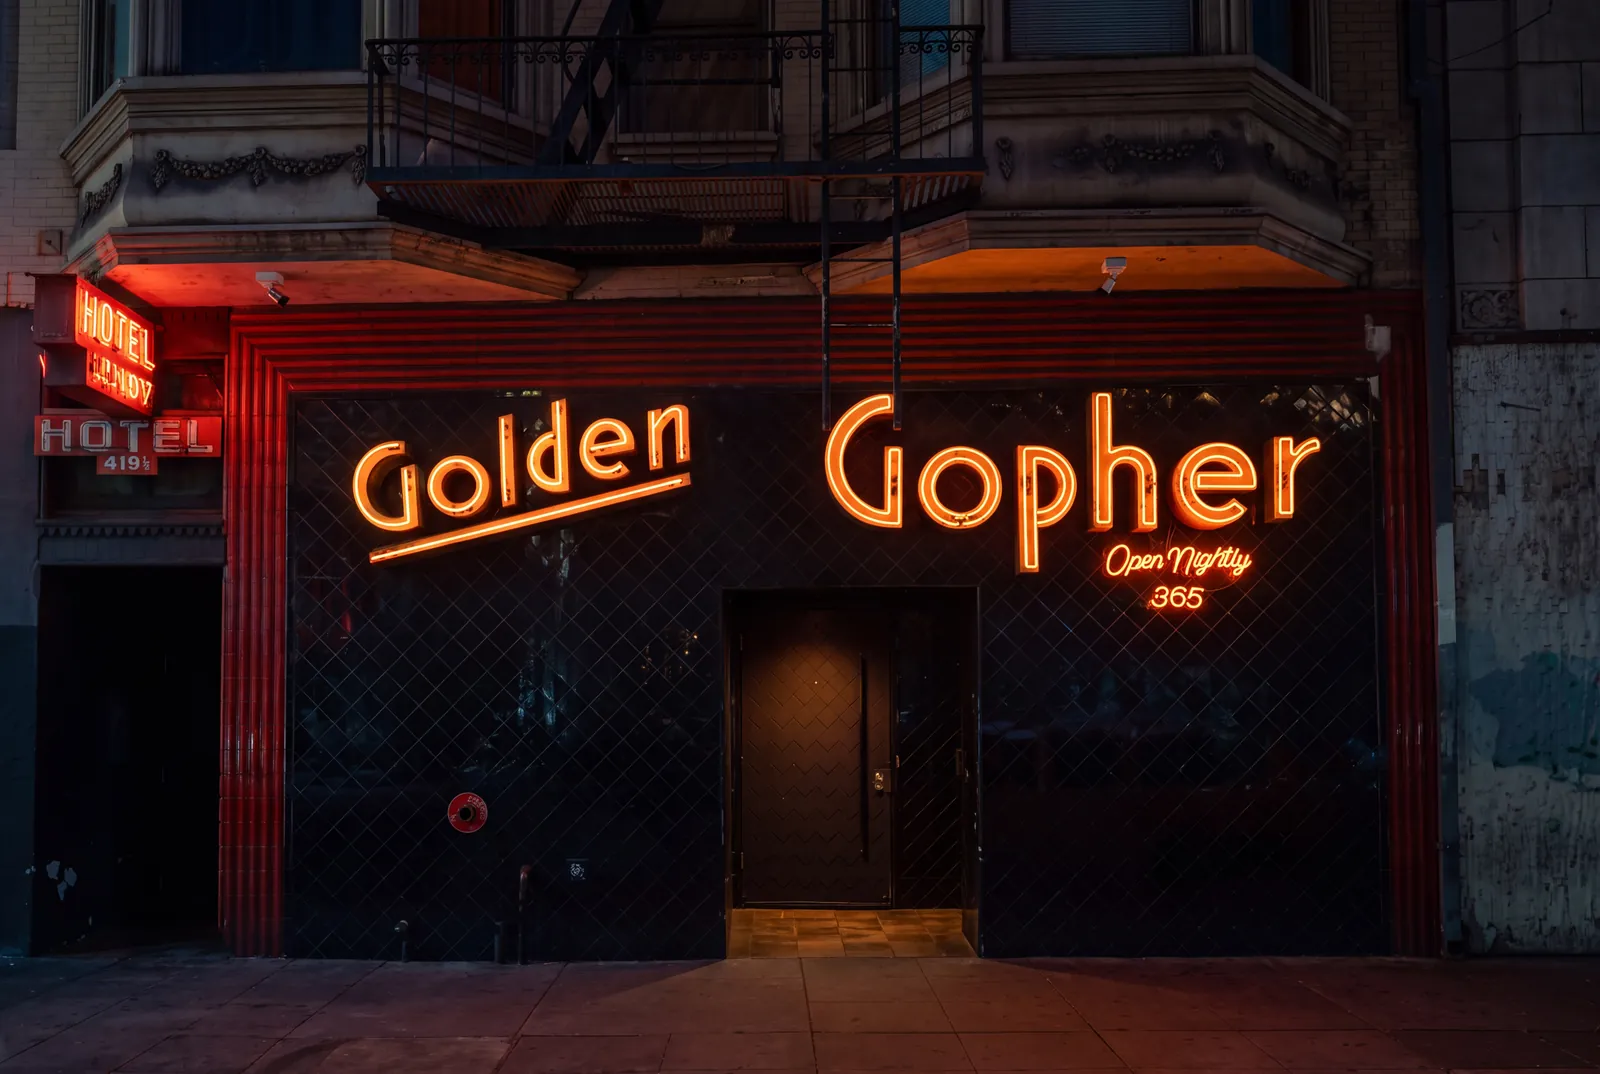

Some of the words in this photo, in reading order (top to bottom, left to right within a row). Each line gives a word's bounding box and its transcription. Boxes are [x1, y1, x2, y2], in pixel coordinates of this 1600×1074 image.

[79, 288, 155, 371] HOTEL
[41, 418, 213, 453] HOTEL
[353, 398, 690, 532] Golden
[825, 391, 1321, 573] Gopher
[1106, 544, 1164, 577] Open
[1167, 546, 1252, 577] Nightly
[1151, 585, 1205, 609] 365
